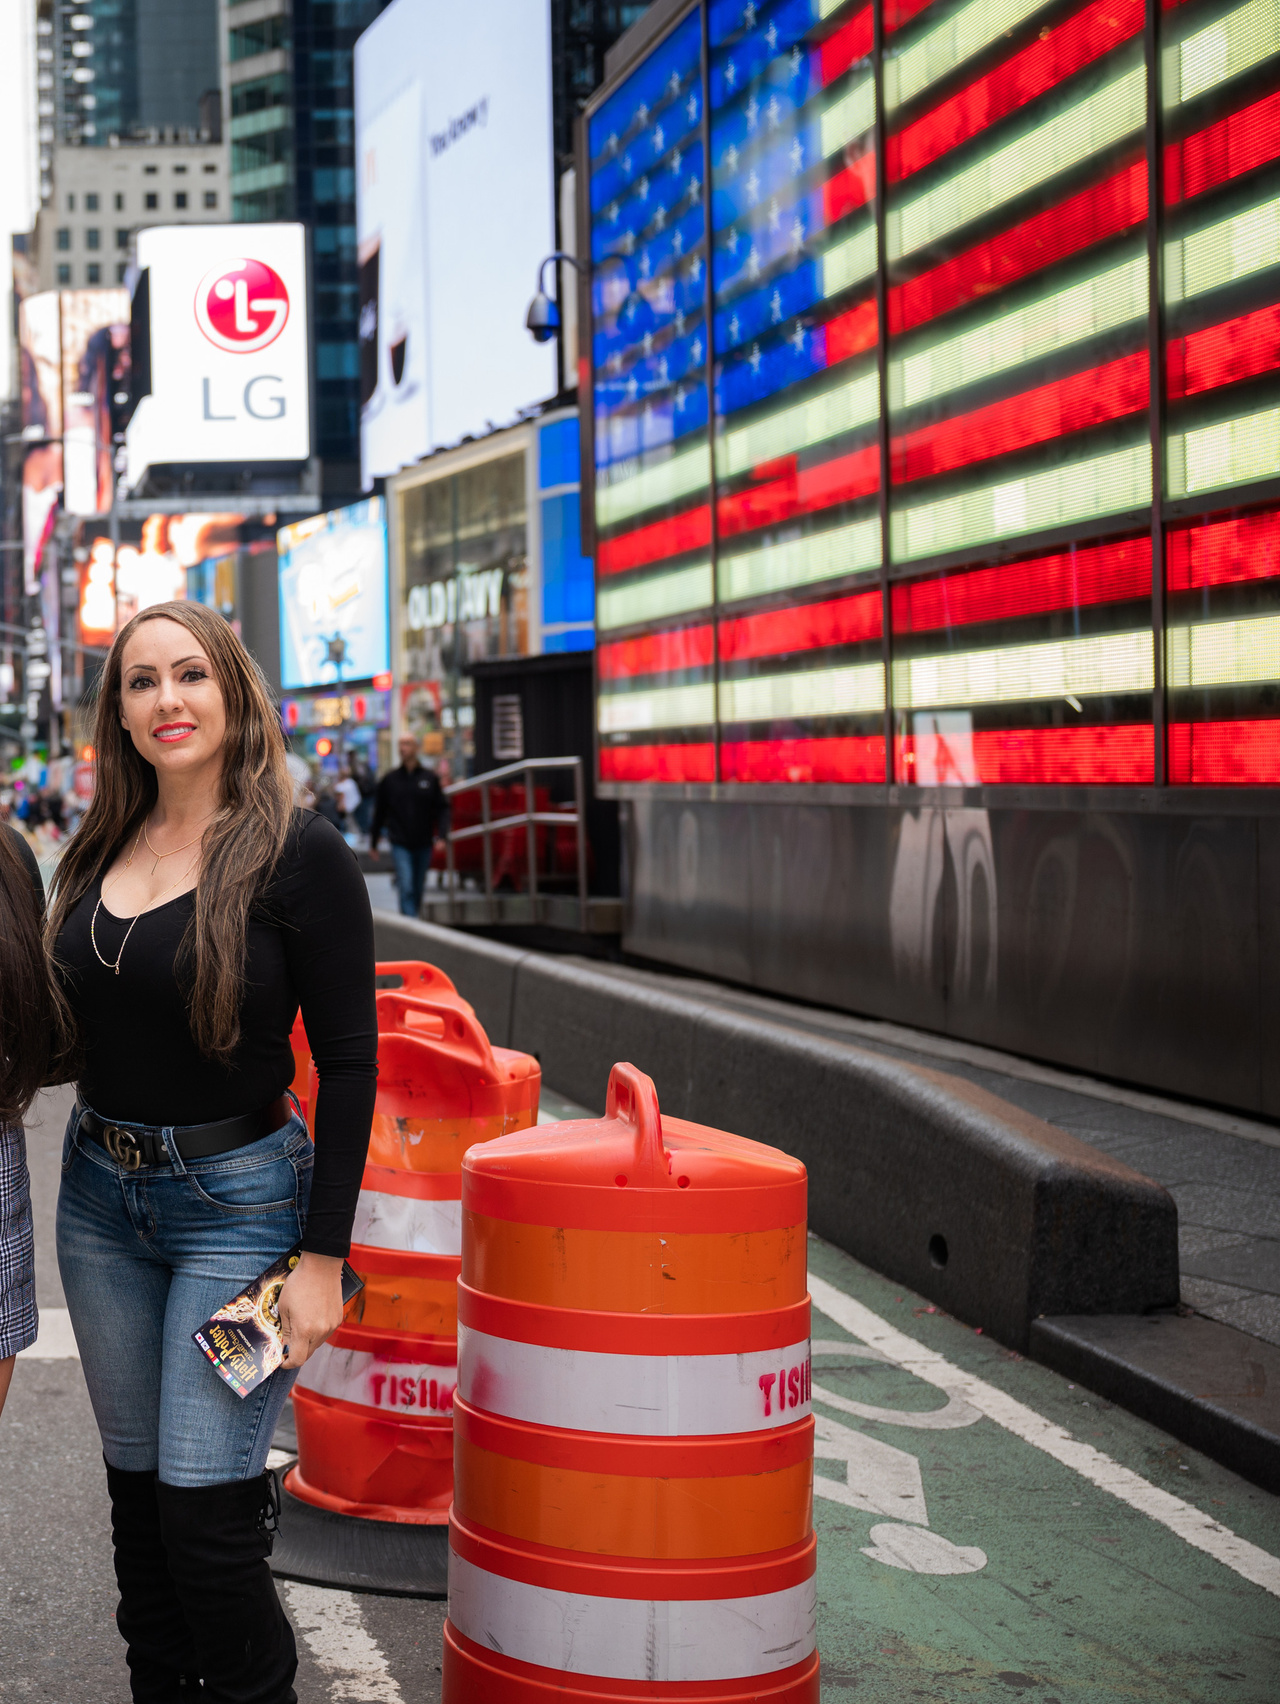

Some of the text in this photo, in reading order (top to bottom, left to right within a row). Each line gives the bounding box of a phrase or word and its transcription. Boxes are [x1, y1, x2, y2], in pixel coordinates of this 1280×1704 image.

[203, 374, 287, 421] LG
[408, 581, 446, 631] OLD
[210, 1324, 237, 1361] Potter
[227, 1328, 241, 1345] CHILD
[229, 1354, 258, 1383] Harry
